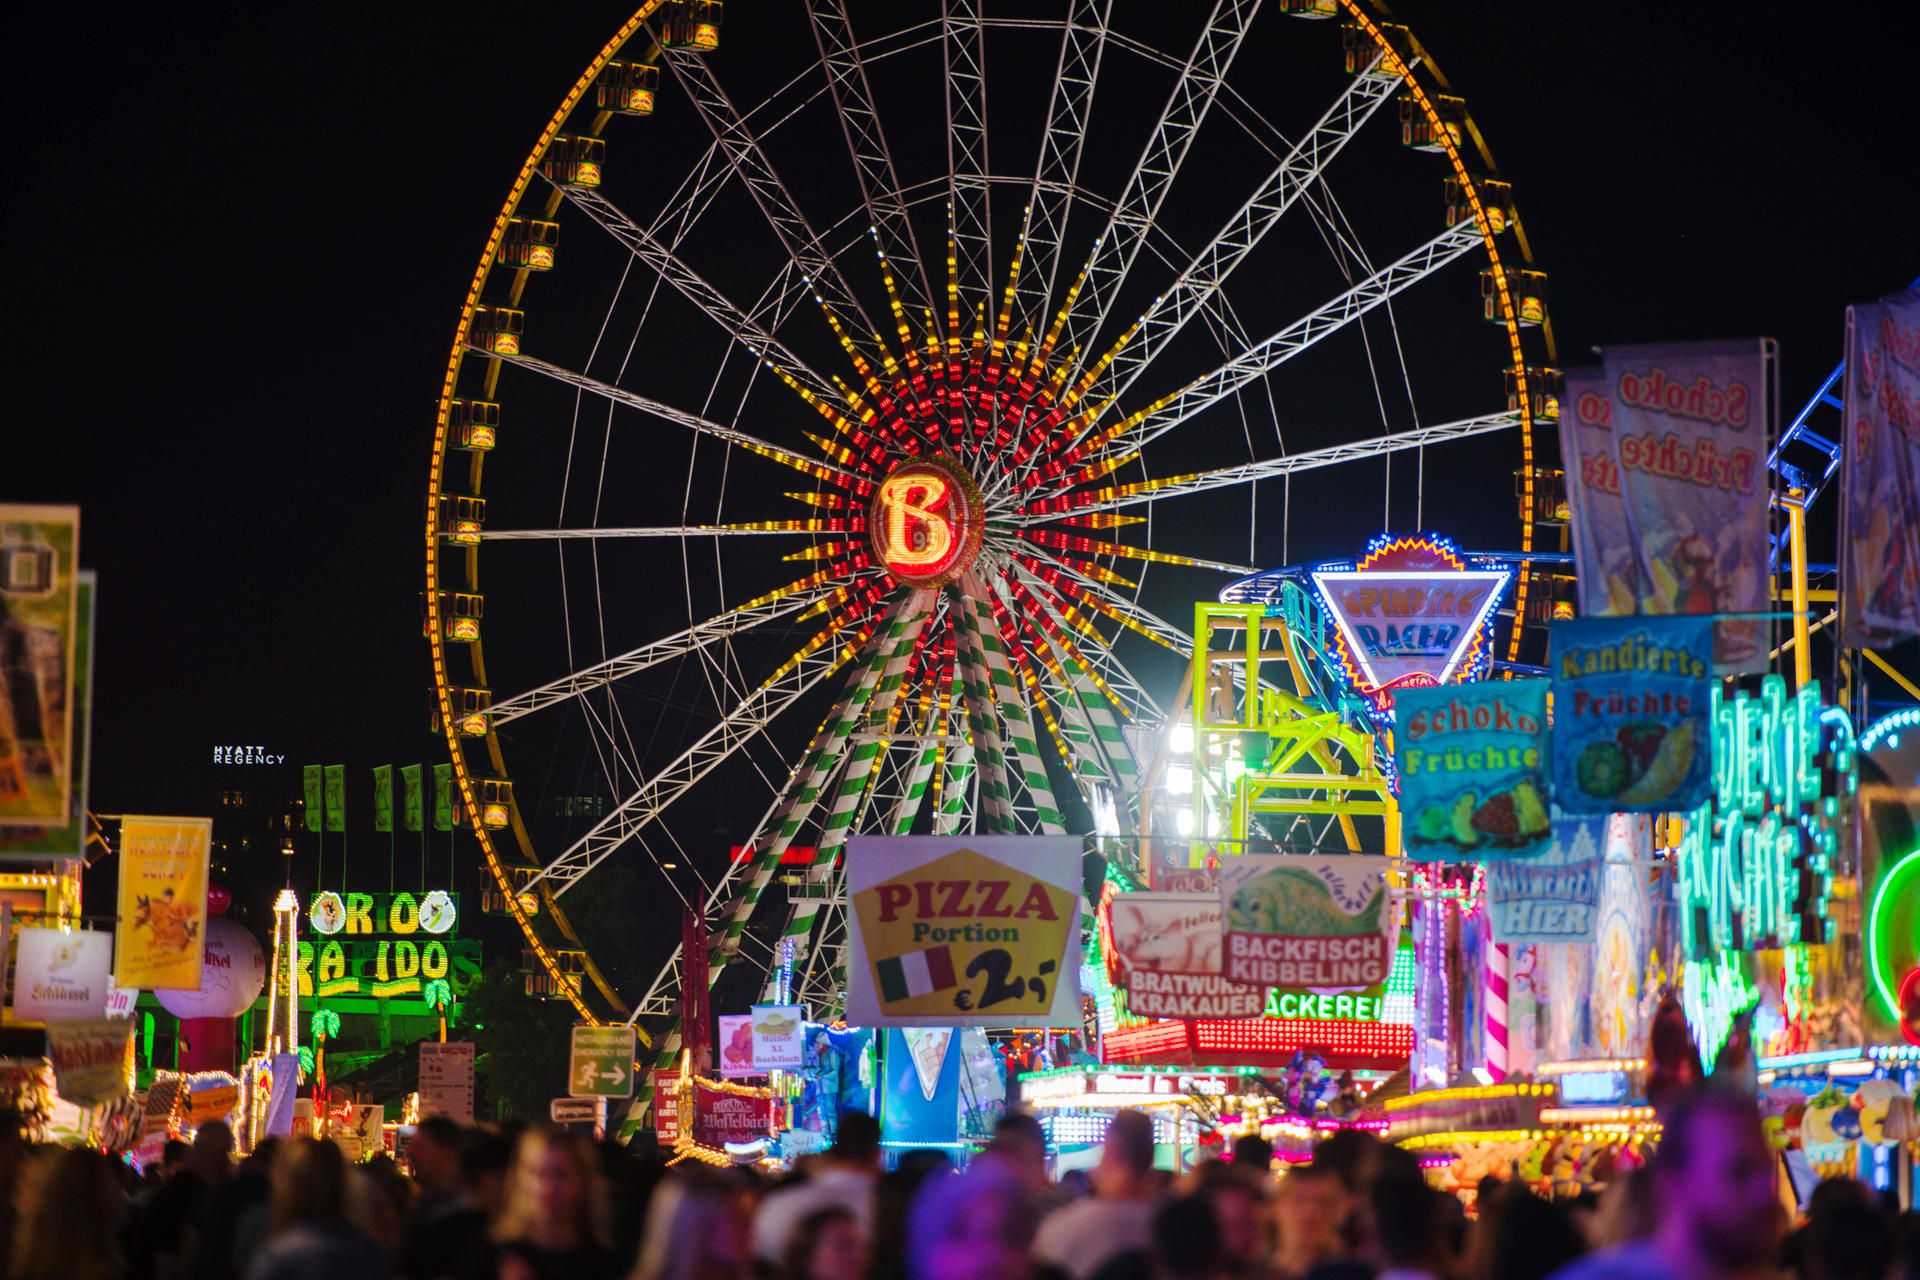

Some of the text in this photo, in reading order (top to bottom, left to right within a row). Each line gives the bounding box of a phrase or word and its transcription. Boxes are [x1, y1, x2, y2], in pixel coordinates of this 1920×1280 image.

[1340, 587, 1484, 617] SPINNING
[1354, 624, 1460, 656] RACER
[1560, 634, 1707, 681] Kandierte
[1573, 690, 1692, 717] Früchte
[1407, 700, 1540, 741] Schoko
[213, 745, 265, 755] HYATT
[213, 755, 285, 764] REGENCY
[1404, 746, 1540, 775] Früchte
[875, 880, 1059, 922] PIZZA
[1502, 900, 1588, 935] HIER
[912, 922, 1020, 943] Portion
[1229, 934, 1381, 961] BACKFISCH
[1230, 957, 1381, 983] KIBBELING
[1130, 992, 1261, 1016] KRAKAUER
[616, 1048, 633, 1057] EXIT
[771, 1045, 784, 1053] XL
